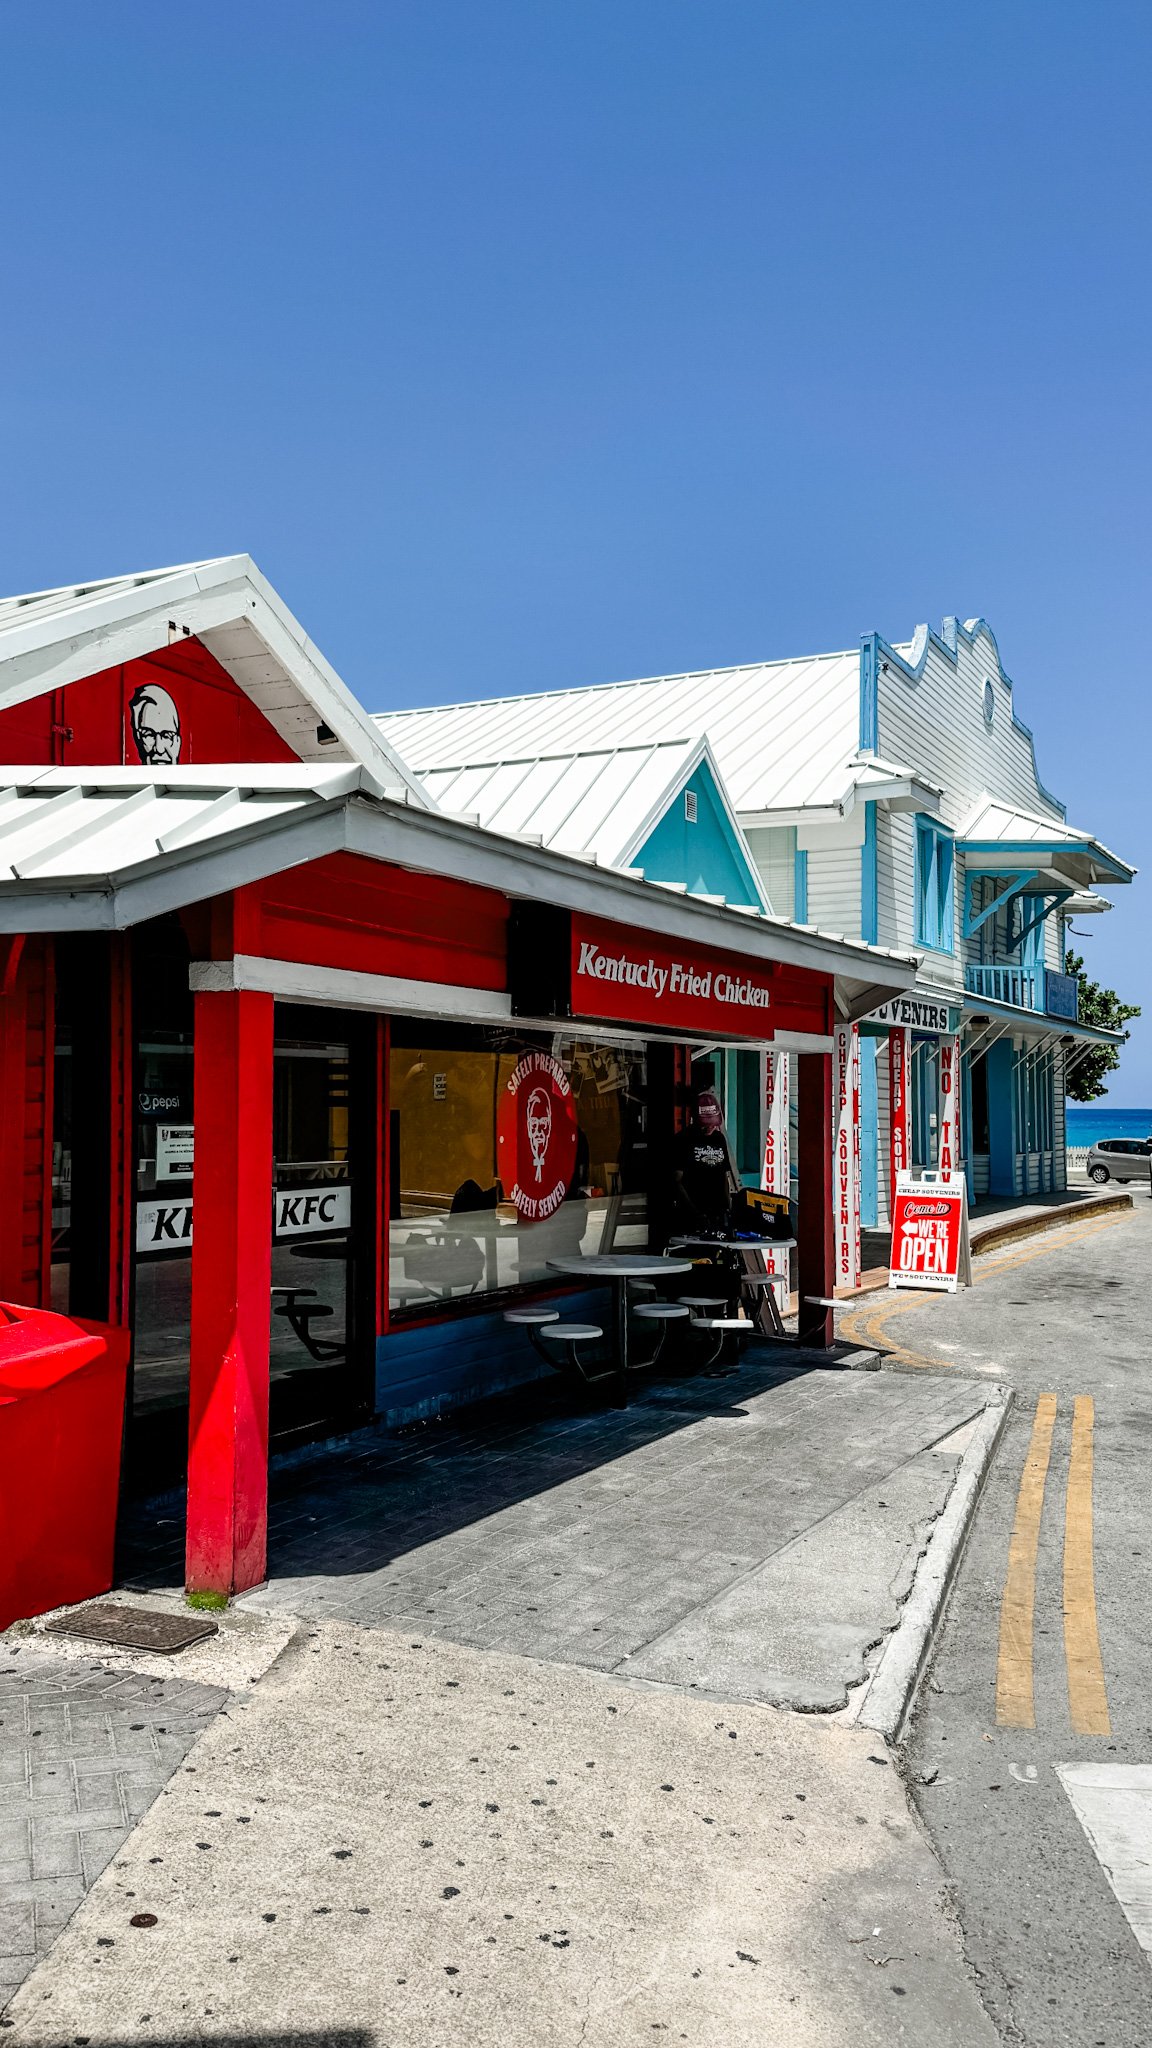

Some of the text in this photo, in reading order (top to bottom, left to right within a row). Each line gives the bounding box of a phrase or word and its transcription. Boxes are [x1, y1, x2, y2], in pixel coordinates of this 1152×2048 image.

[577, 942, 770, 1008] Kentucky Fried Chicken
[868, 1000, 947, 1030] UVENIRS
[507, 1052, 571, 1097] SAFELY PREPARED
[765, 1052, 775, 1110] EAP
[941, 1047, 951, 1094] NO
[152, 1095, 180, 1110] pepsi
[892, 1040, 903, 1173] CHEAP SOU
[838, 1033, 850, 1274] CHEAP SOUVENIRS
[278, 1195, 338, 1228] KFC
[510, 1180, 566, 1218] SAFELY SERVED
[904, 1201, 950, 1218] Come in
[918, 1219, 950, 1239] WE'RE
[900, 1236, 949, 1273] OPEN
[910, 1274, 954, 1282] SOUVENIRS
